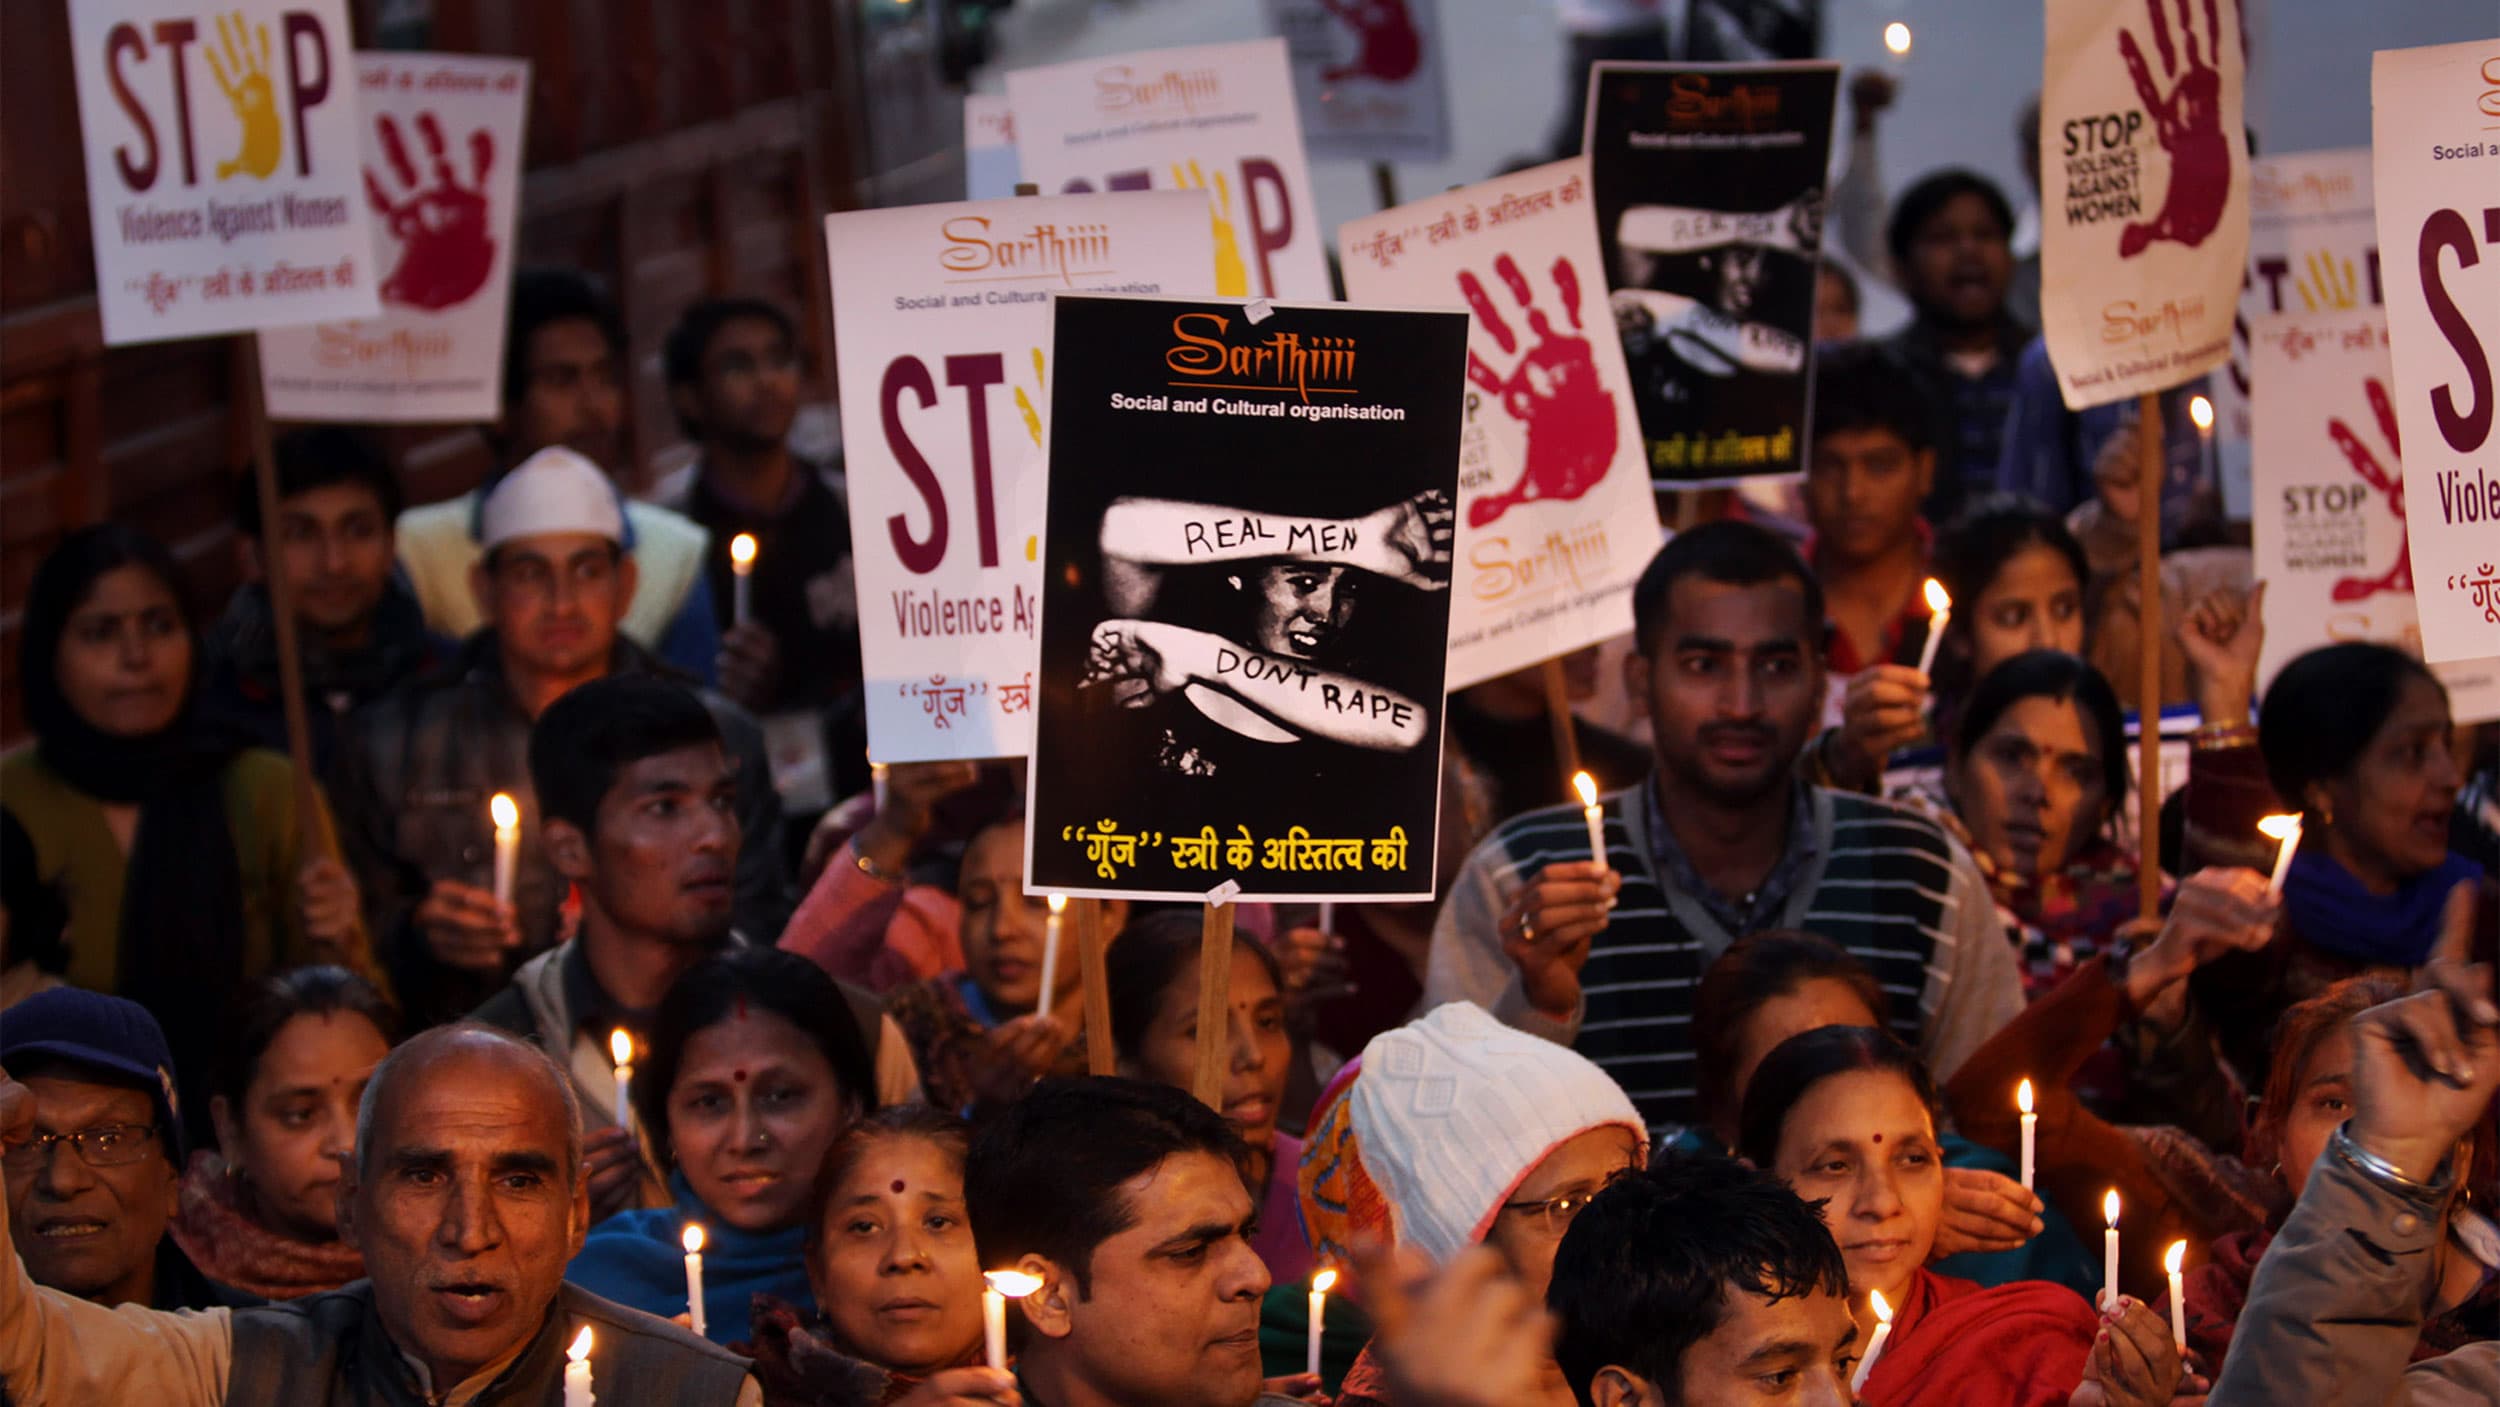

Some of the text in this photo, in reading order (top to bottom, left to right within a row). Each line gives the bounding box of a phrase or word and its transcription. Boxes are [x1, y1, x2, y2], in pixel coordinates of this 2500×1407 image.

[103, 12, 333, 192] STP
[2064, 110, 2142, 156] STOP
[2433, 143, 2484, 160] Social
[2065, 150, 2139, 176] VIOLENCE
[2066, 171, 2140, 200] AGAINST
[117, 205, 202, 243] Violence
[283, 194, 347, 229] Women
[1463, 205, 1480, 231] के
[1559, 175, 1583, 205] की
[2067, 197, 2141, 225] WOMEN
[940, 216, 1110, 286] Sarthiiii
[895, 293, 946, 311] Social
[952, 292, 981, 307] and
[986, 289, 1048, 306] Cultura
[1166, 313, 1356, 404] Sarthiiii
[1110, 393, 1405, 421] Social and Cultural organisation
[2283, 484, 2367, 515] STOP
[1185, 517, 1358, 555] REAL MEN
[1469, 521, 1609, 601] Sarthiiii
[892, 588, 1003, 638] Violence
[1216, 648, 1413, 729] DONT RAPE
[1062, 819, 1408, 880] “गूँज” स्त्री के अस्तित्व की
